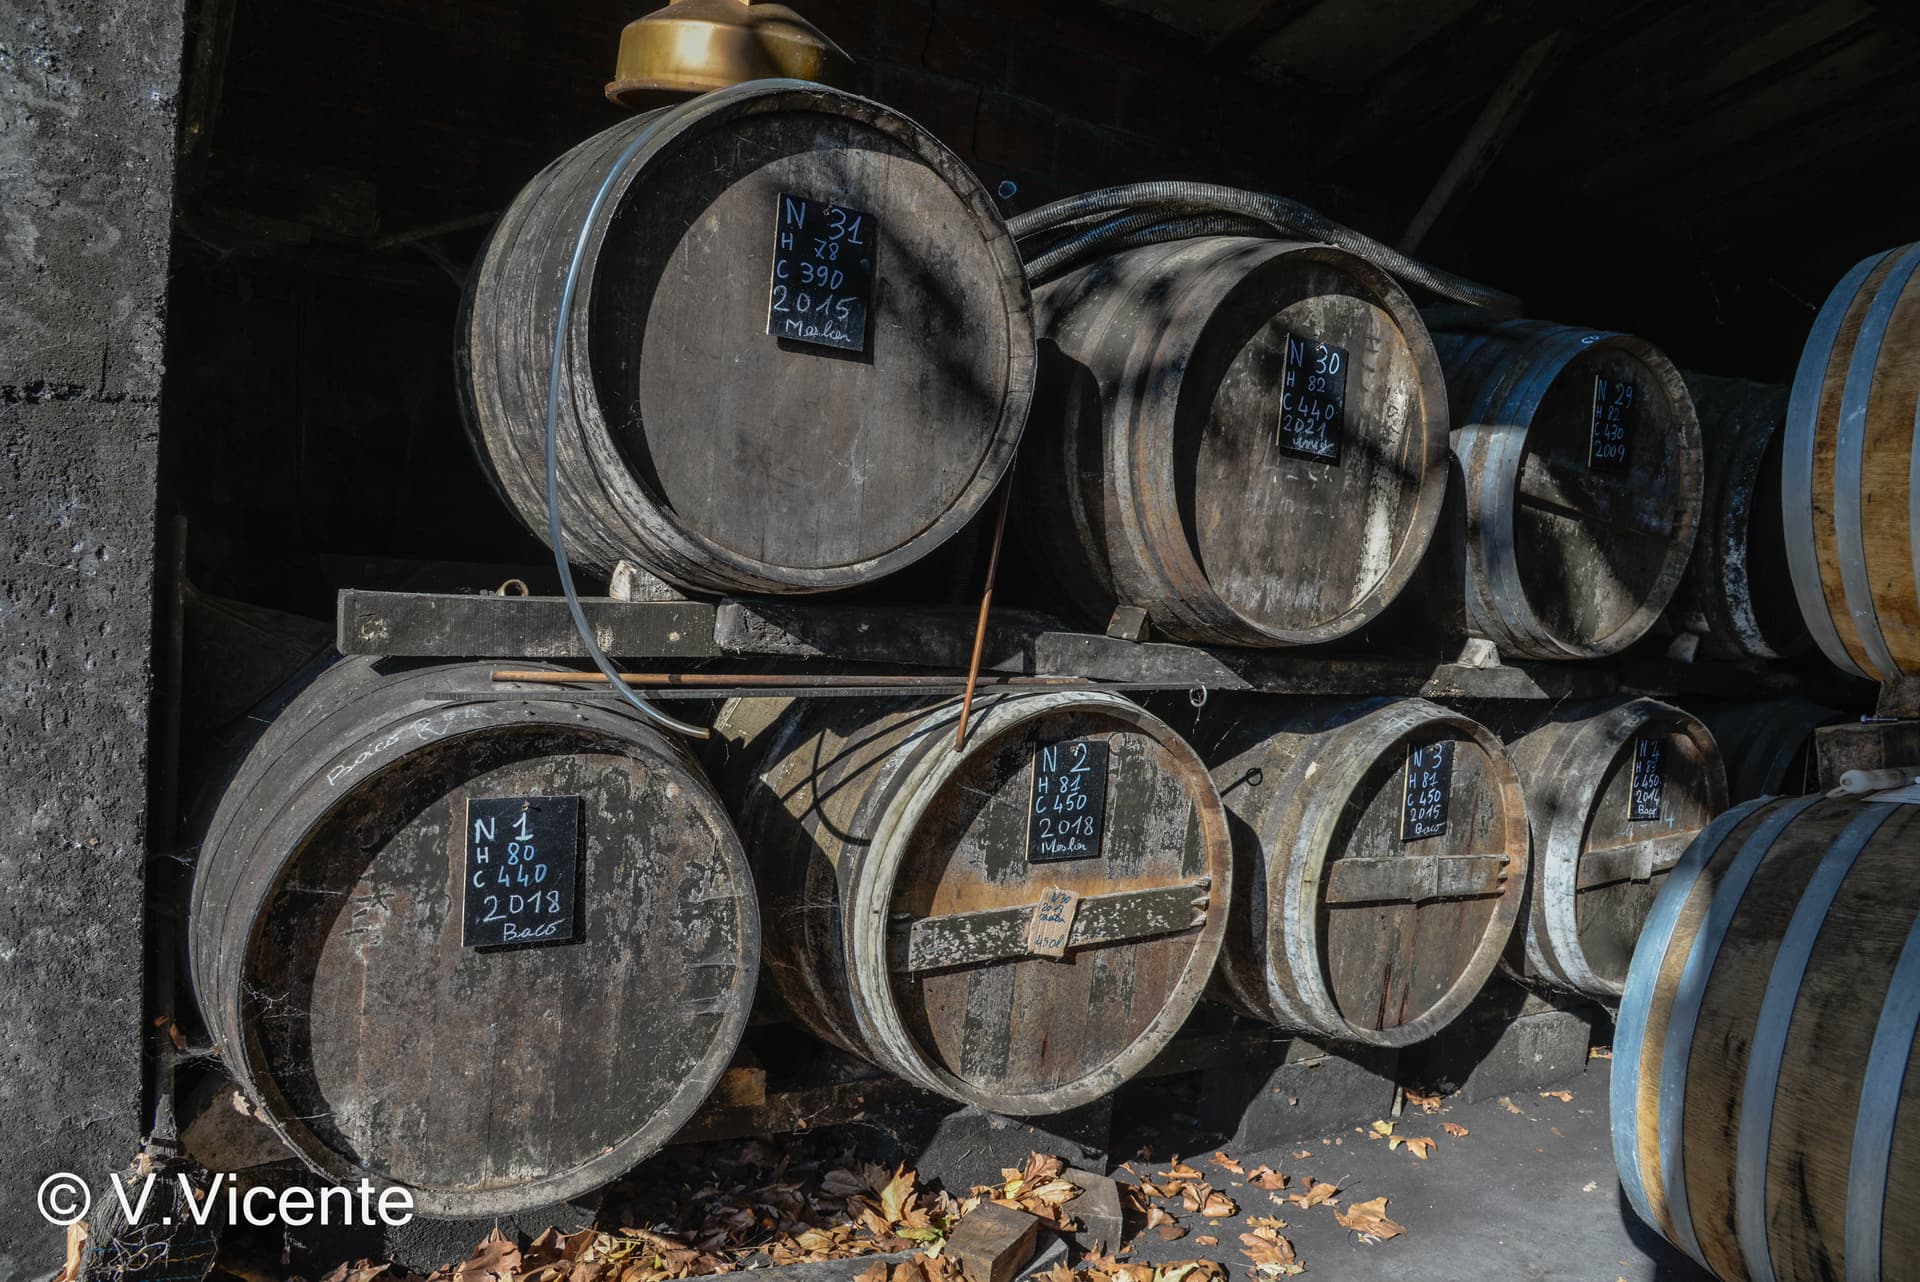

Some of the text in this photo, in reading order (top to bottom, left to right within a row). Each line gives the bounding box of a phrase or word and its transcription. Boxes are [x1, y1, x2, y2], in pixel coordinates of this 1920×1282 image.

[787, 198, 863, 245] N 31
[782, 232, 840, 261] H 78
[777, 260, 844, 290] C 390
[773, 285, 857, 320] 2015
[1290, 339, 1340, 374] N 30
[1287, 370, 1326, 392] H 82
[1598, 379, 1633, 408] N 29
[1283, 393, 1335, 420] C 440
[1596, 405, 1603, 418] H
[1283, 414, 1326, 441] 2021
[1594, 422, 1600, 436] C
[1594, 440, 1625, 463] 2009
[1043, 742, 1091, 773] N 2
[1413, 743, 1443, 769] N 3
[1640, 740, 1661, 761] N 4
[1636, 761, 1642, 773] H
[1039, 774, 1081, 794] H 81
[1409, 772, 1417, 788] H
[1641, 774, 1660, 790] 450
[1036, 792, 1087, 814] C 450
[1407, 788, 1442, 807] C 450
[1636, 788, 1661, 806] 2014
[1410, 804, 1442, 822] 2015
[475, 812, 534, 844] N 1
[1039, 815, 1094, 838] 2018
[477, 842, 535, 865] H 80
[473, 863, 548, 888] C 440
[483, 890, 560, 922] 2018
[504, 918, 565, 941] Baco
